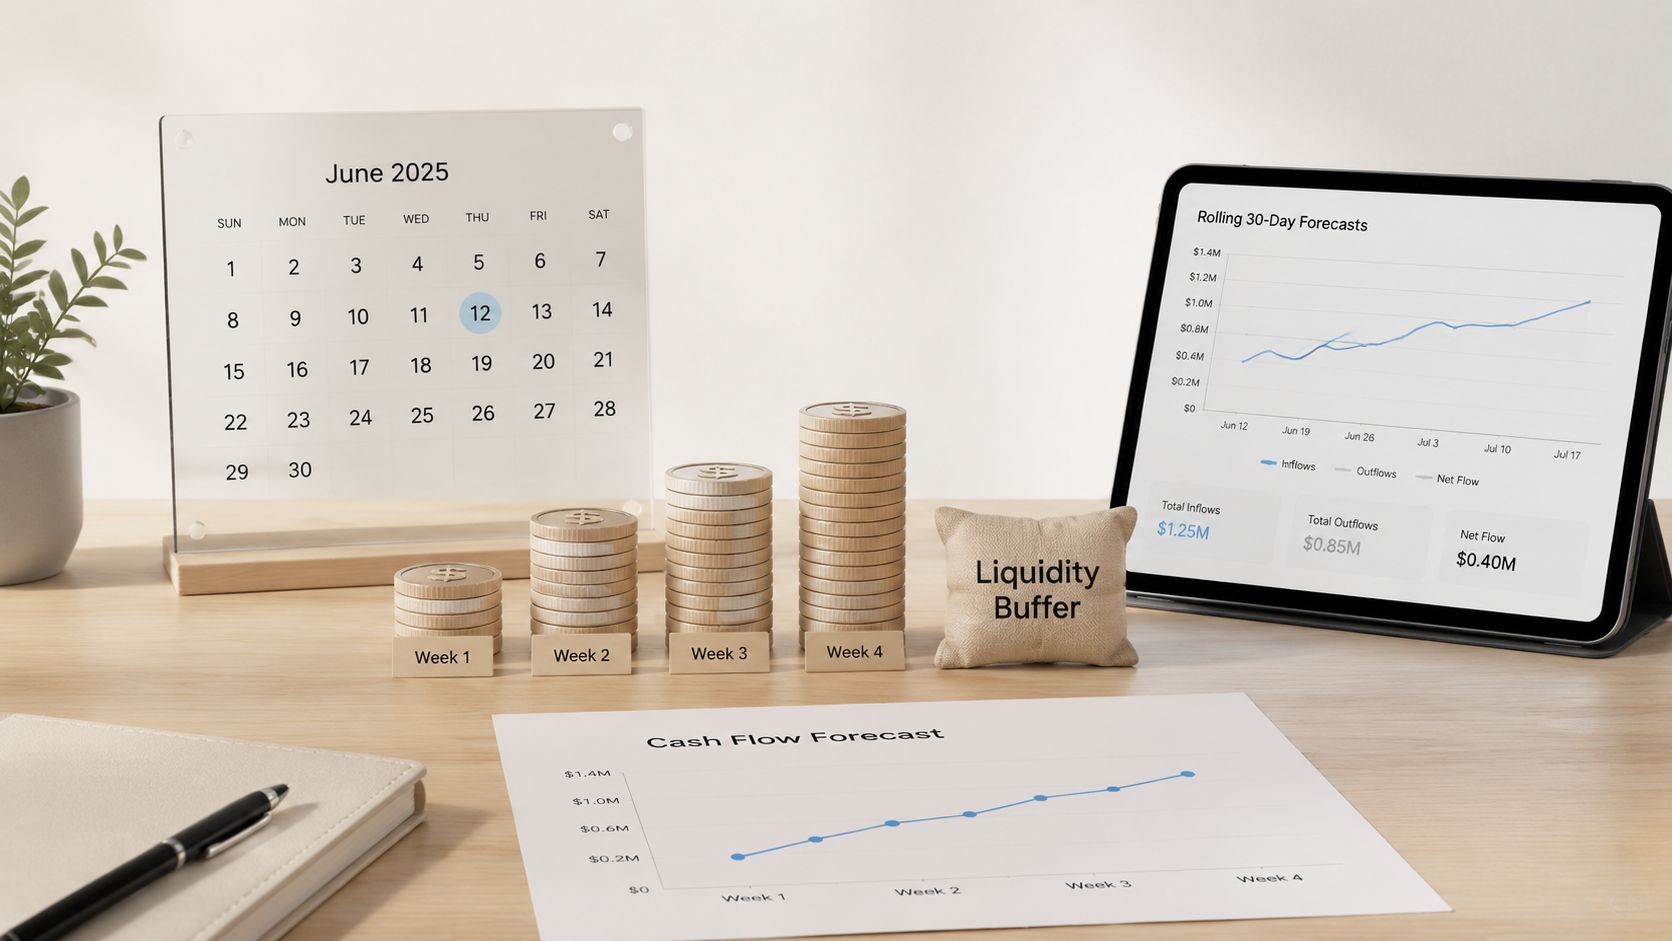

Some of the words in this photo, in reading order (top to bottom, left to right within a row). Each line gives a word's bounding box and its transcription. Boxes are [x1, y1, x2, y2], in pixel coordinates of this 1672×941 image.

[325, 163, 384, 184] June
[391, 161, 449, 183] 2025
[217, 217, 242, 229] SUN
[278, 216, 307, 227] MON
[342, 214, 366, 226] TUE
[402, 213, 430, 225] WED
[465, 212, 490, 223] THU
[529, 210, 547, 221] FRI
[588, 208, 611, 220] SAT
[1197, 209, 1243, 228] Rolling
[1245, 212, 1297, 231] 30-Day
[1299, 215, 1368, 232] Forecasts
[1192, 247, 1222, 258] $1.4M
[227, 260, 234, 277] 1
[288, 258, 300, 276] 2
[351, 257, 362, 274] 3
[411, 255, 424, 272] 4
[473, 253, 485, 271] 5
[534, 252, 546, 269] 6
[595, 250, 607, 268] 7
[1189, 271, 1217, 283] $1.2M
[1184, 297, 1213, 309] $1.0M
[227, 311, 239, 329] 8
[289, 309, 302, 327] 9
[347, 308, 369, 326] 10
[410, 306, 427, 324] 11
[470, 304, 491, 322] 12
[532, 303, 552, 320] 13
[592, 301, 613, 318] 14
[1179, 323, 1209, 335] $0.8M
[223, 362, 245, 381] 15
[286, 360, 309, 378] 16
[349, 358, 370, 376] 17
[410, 356, 432, 374] 18
[471, 354, 493, 372] 19
[532, 352, 556, 370] 20
[593, 351, 612, 368] 21
[1170, 376, 1201, 388] $0.2M
[224, 413, 248, 431] 22
[287, 411, 311, 429] 23
[349, 409, 373, 427] 24
[411, 406, 434, 424] 25
[472, 404, 495, 422] 26
[533, 402, 556, 420] 27
[593, 400, 616, 417] 28
[1183, 403, 1196, 414] $0
[1220, 420, 1237, 430] Jun
[1238, 421, 1249, 431] 12
[1281, 425, 1299, 435] Jun
[1300, 427, 1311, 437] 19
[1344, 431, 1361, 441] Jun
[1362, 432, 1375, 442] 26
[1417, 437, 1430, 448] Jul
[1432, 438, 1440, 448] 3
[1483, 443, 1498, 454] Jul
[1500, 444, 1512, 455] 10
[1553, 449, 1569, 460] Jul
[1570, 450, 1582, 461] 17
[225, 463, 249, 481] 29
[288, 461, 312, 479] 30
[1356, 465, 1397, 479] Outflows
[1436, 473, 1455, 485] Net
[1456, 475, 1480, 487] Flow
[1161, 499, 1186, 512] Total
[1186, 502, 1221, 515] Inflows
[1307, 514, 1333, 527] Total
[1333, 516, 1379, 532] Outflows
[1156, 520, 1210, 541] $1.25M
[1460, 529, 1480, 541] Net
[1481, 531, 1506, 544] Flow
[1303, 534, 1361, 556] $0.85M
[1456, 550, 1517, 572] $0.40M
[976, 558, 1101, 590] Liquidity
[994, 595, 1082, 620] Buffer
[414, 650, 459, 665] Week
[462, 650, 469, 664] 1
[553, 648, 597, 663] Week
[600, 648, 611, 662] 2
[691, 646, 735, 661] Week
[738, 646, 748, 660] 3
[826, 644, 868, 659] Week
[873, 644, 884, 659] 4
[646, 733, 722, 749] Cash
[730, 730, 801, 746] Flow
[810, 728, 945, 743] Forecast
[564, 769, 611, 779] $1.4M
[572, 797, 620, 806] $1.0M
[580, 824, 630, 834] $0.6M
[588, 854, 640, 864] $0.2M
[1064, 880, 1116, 890] Week
[1119, 879, 1133, 888] 3
[1236, 874, 1288, 884] Week
[1292, 873, 1303, 881] 4
[628, 886, 650, 895] $0
[721, 893, 773, 903] Week
[777, 892, 786, 901] 1
[894, 887, 946, 897] Week
[949, 886, 961, 895] 2
